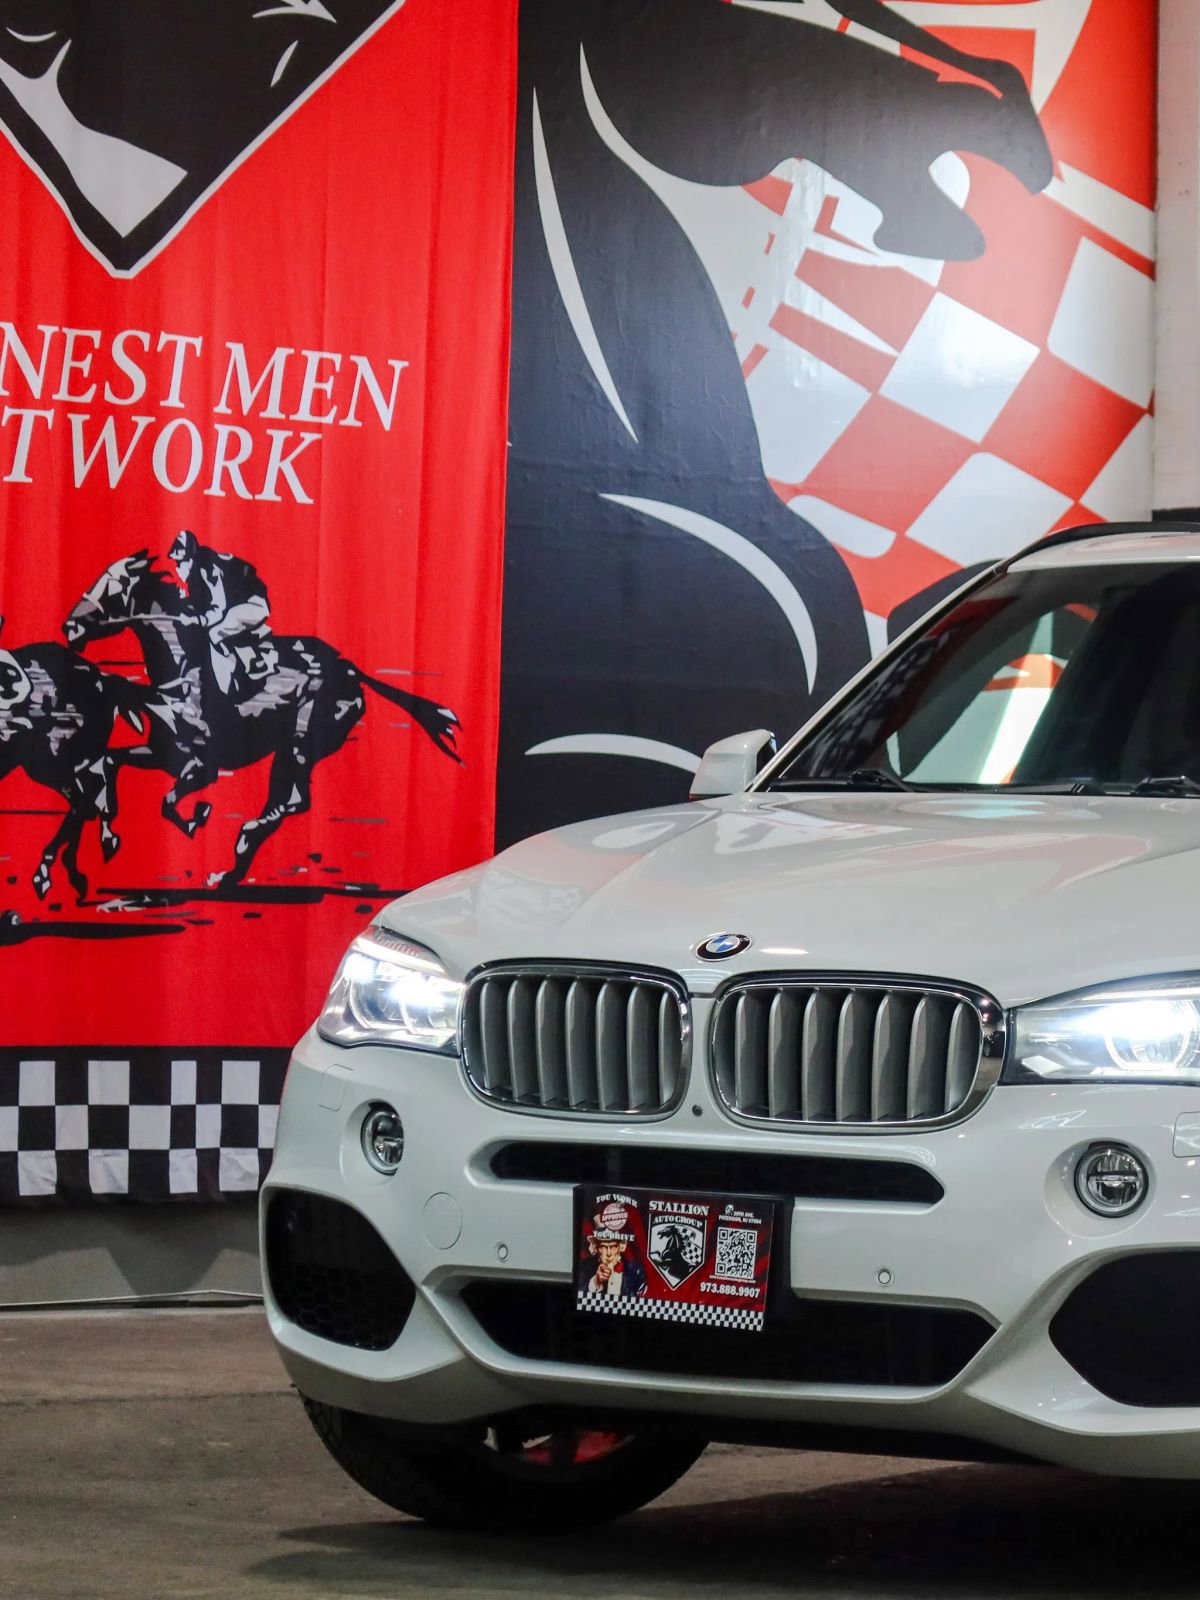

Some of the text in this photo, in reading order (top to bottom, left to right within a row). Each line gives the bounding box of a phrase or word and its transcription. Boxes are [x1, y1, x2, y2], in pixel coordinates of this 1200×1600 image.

[0, 321, 409, 431] NEST MEN
[66, 413, 322, 505] WORK
[596, 1193, 611, 1204] YOU
[612, 1193, 638, 1209] WORK
[649, 1200, 710, 1217] STALLION
[610, 1231, 635, 1242] DRIVE
[700, 1281, 760, 1298] 973.888.9907
